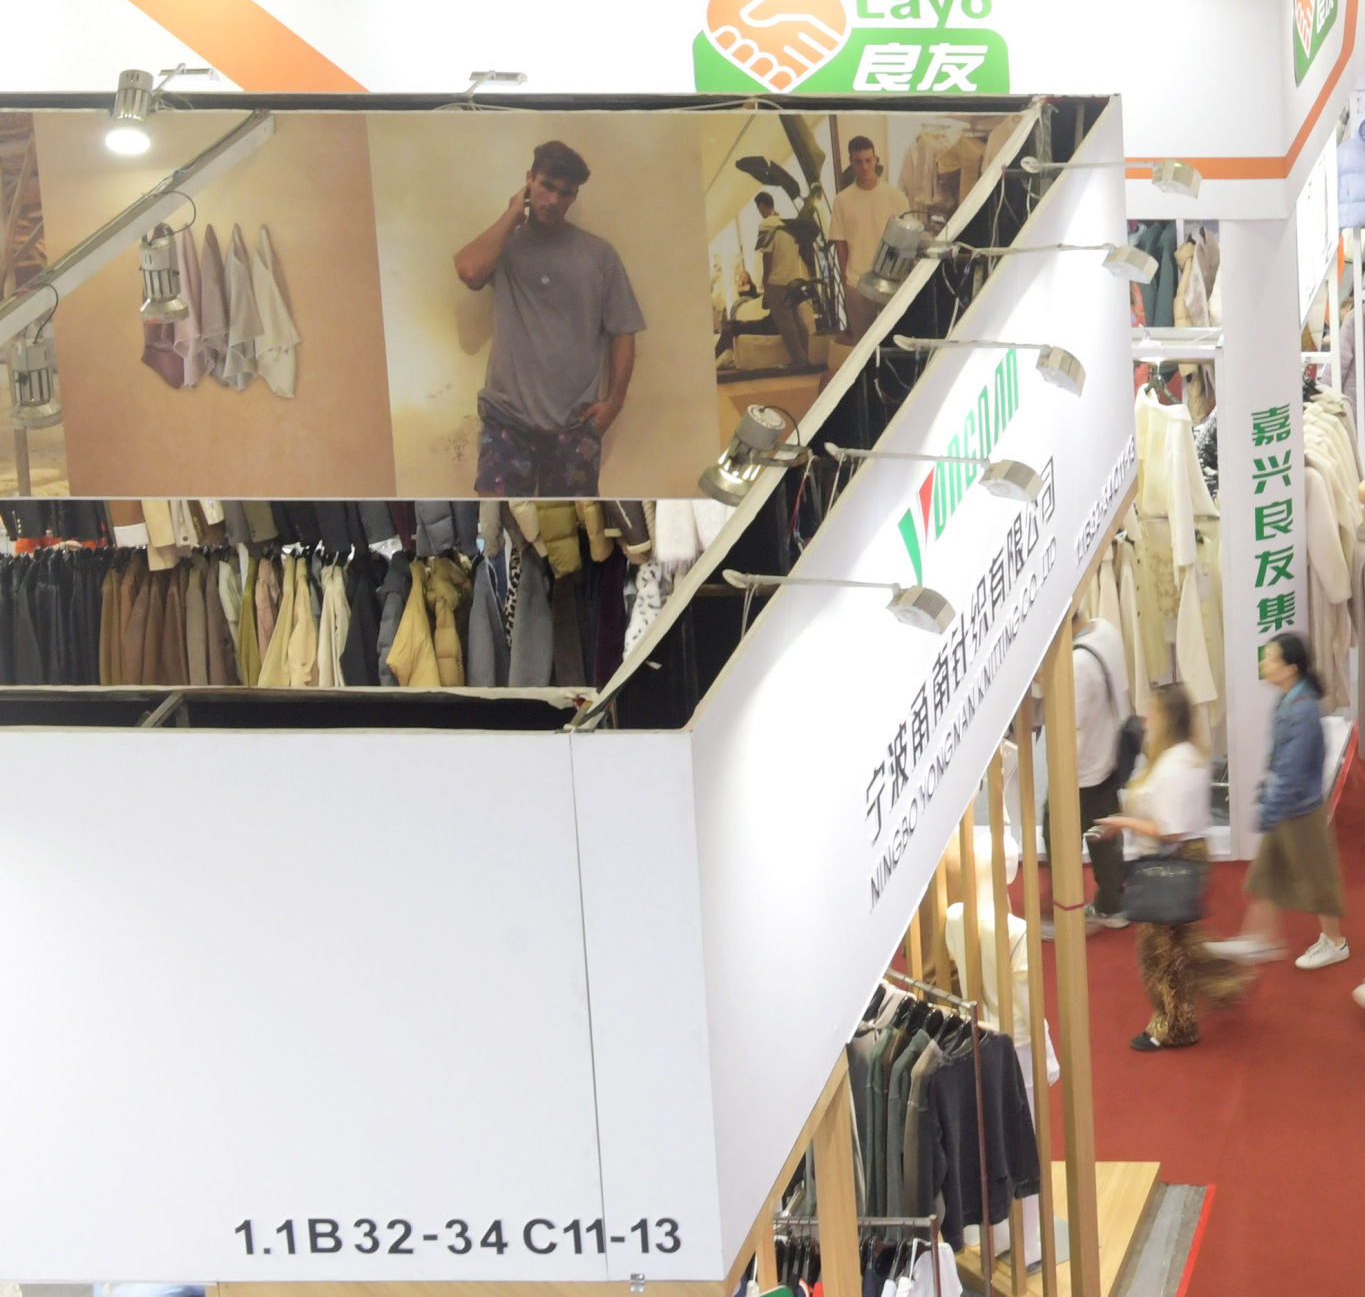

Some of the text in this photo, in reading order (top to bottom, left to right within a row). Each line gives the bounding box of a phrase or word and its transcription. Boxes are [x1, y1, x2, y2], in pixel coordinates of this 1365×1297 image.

[853, 42, 990, 92] 良友
[1251, 403, 1297, 681] 嘉兴良友集
[865, 455, 1056, 847] 宁波甬南针织有限公司
[871, 797, 918, 911] NINGBO
[521, 1218, 683, 1255] C11-13
